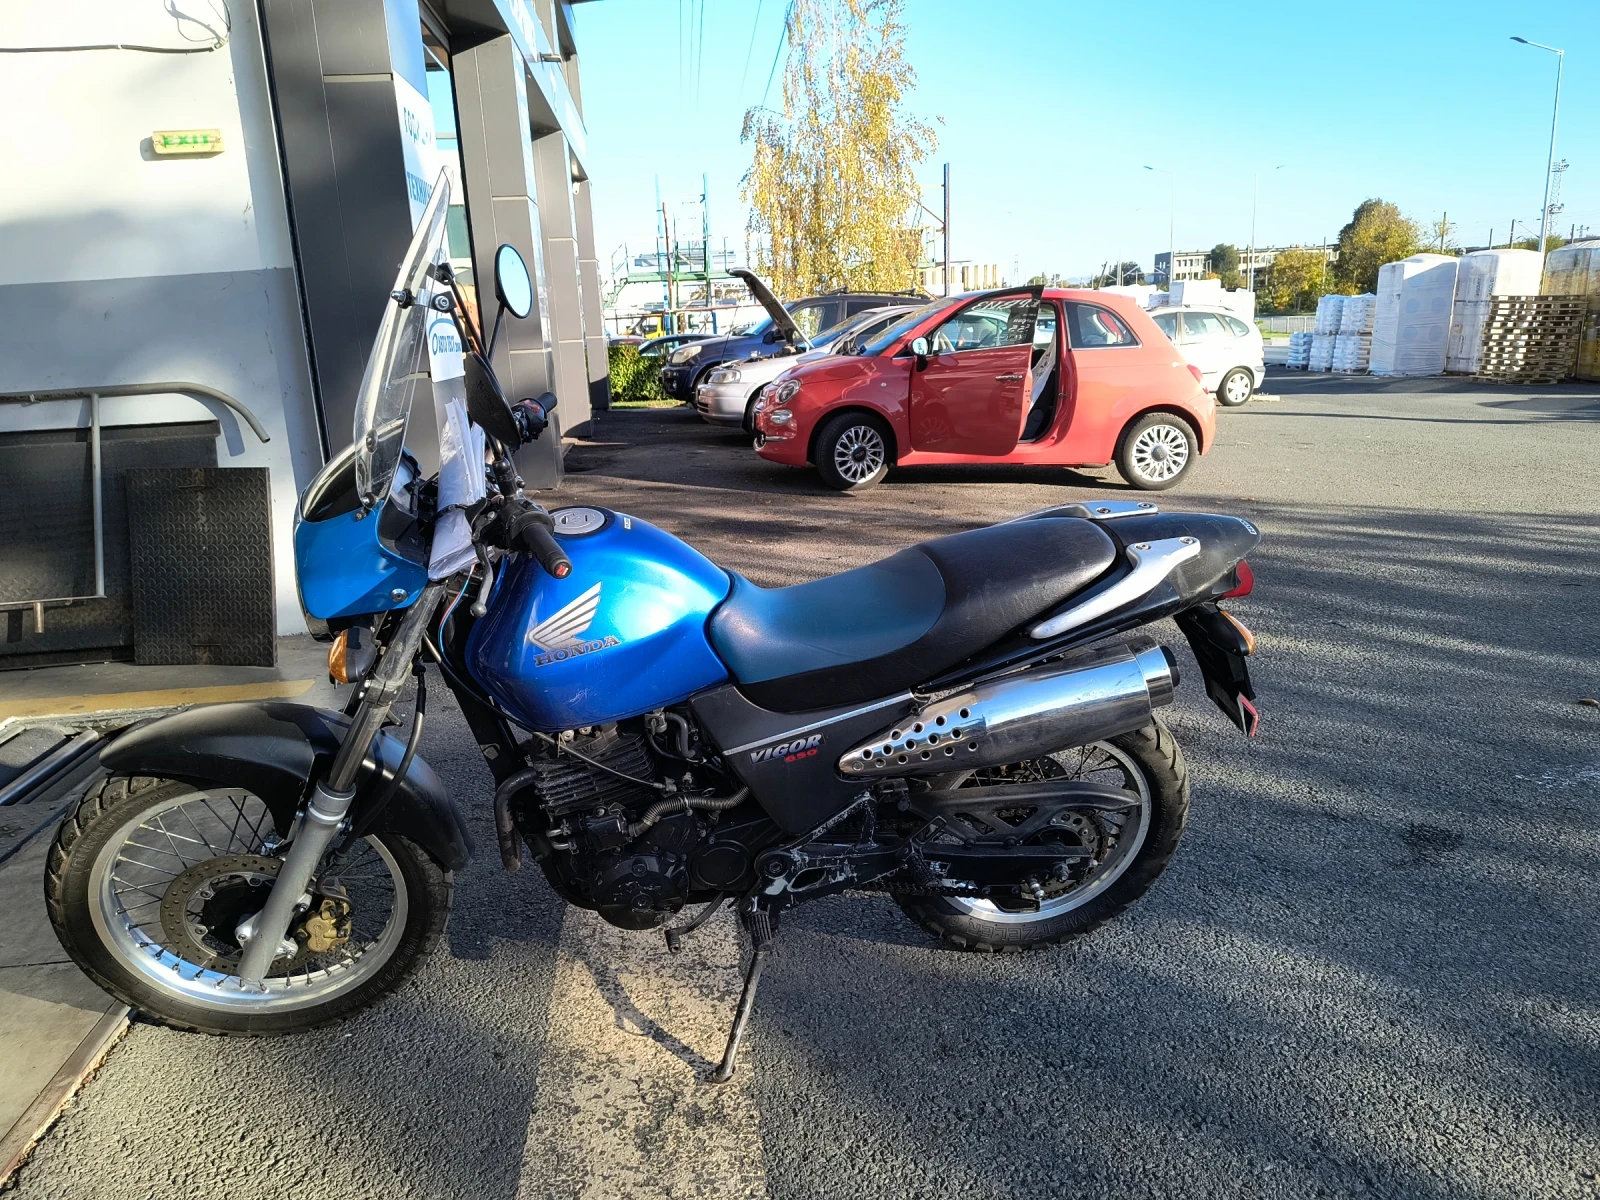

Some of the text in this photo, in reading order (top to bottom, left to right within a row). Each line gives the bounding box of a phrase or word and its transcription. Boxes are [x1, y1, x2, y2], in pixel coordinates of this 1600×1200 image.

[163, 134, 209, 147] EXIT
[533, 635, 621, 667] HONDA
[750, 734, 822, 764] VIGOR
[784, 748, 818, 763] 650
[966, 909, 1091, 941] METZELER
